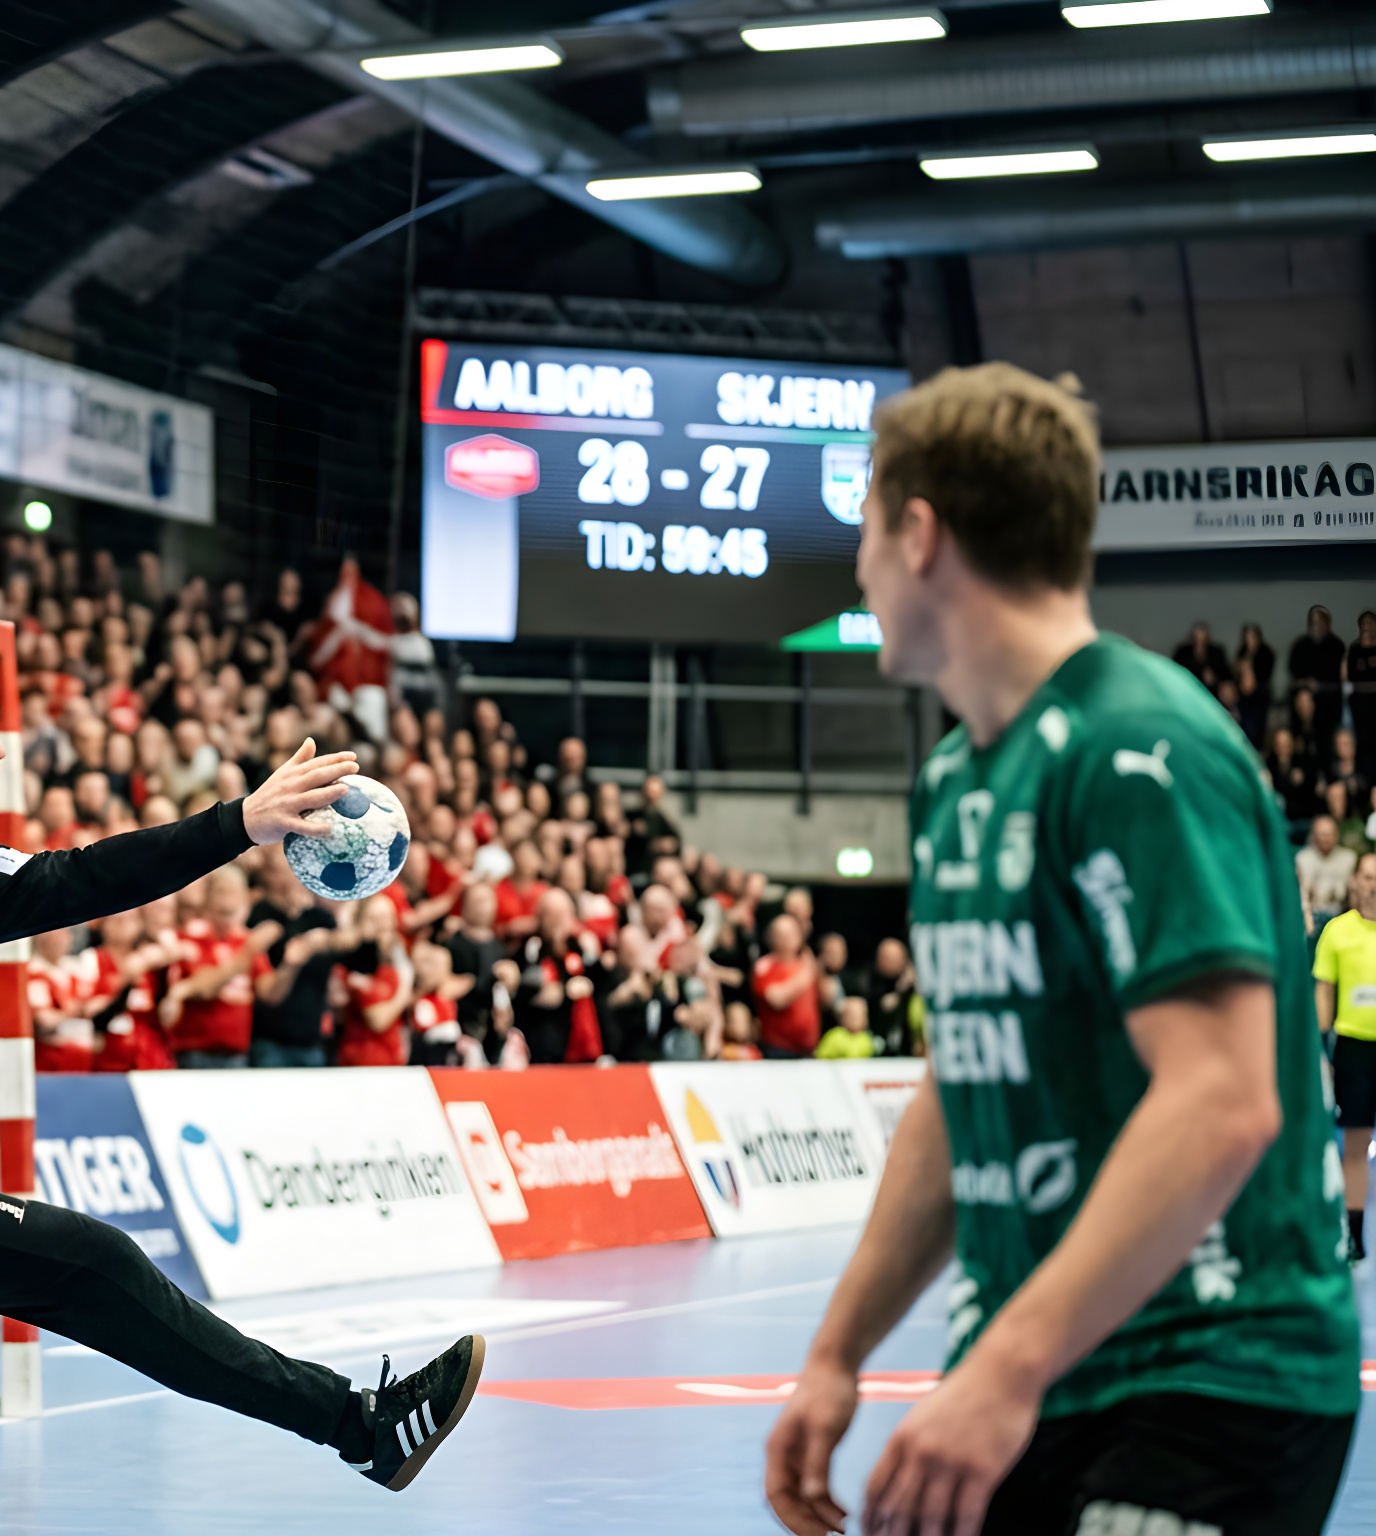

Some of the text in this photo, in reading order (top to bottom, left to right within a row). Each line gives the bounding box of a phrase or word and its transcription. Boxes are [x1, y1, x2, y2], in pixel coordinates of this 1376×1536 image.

[453, 357, 876, 431] AALBORG SKJERN
[577, 438, 650, 506] 28
[699, 444, 771, 511] 27
[579, 519, 656, 573] TID:
